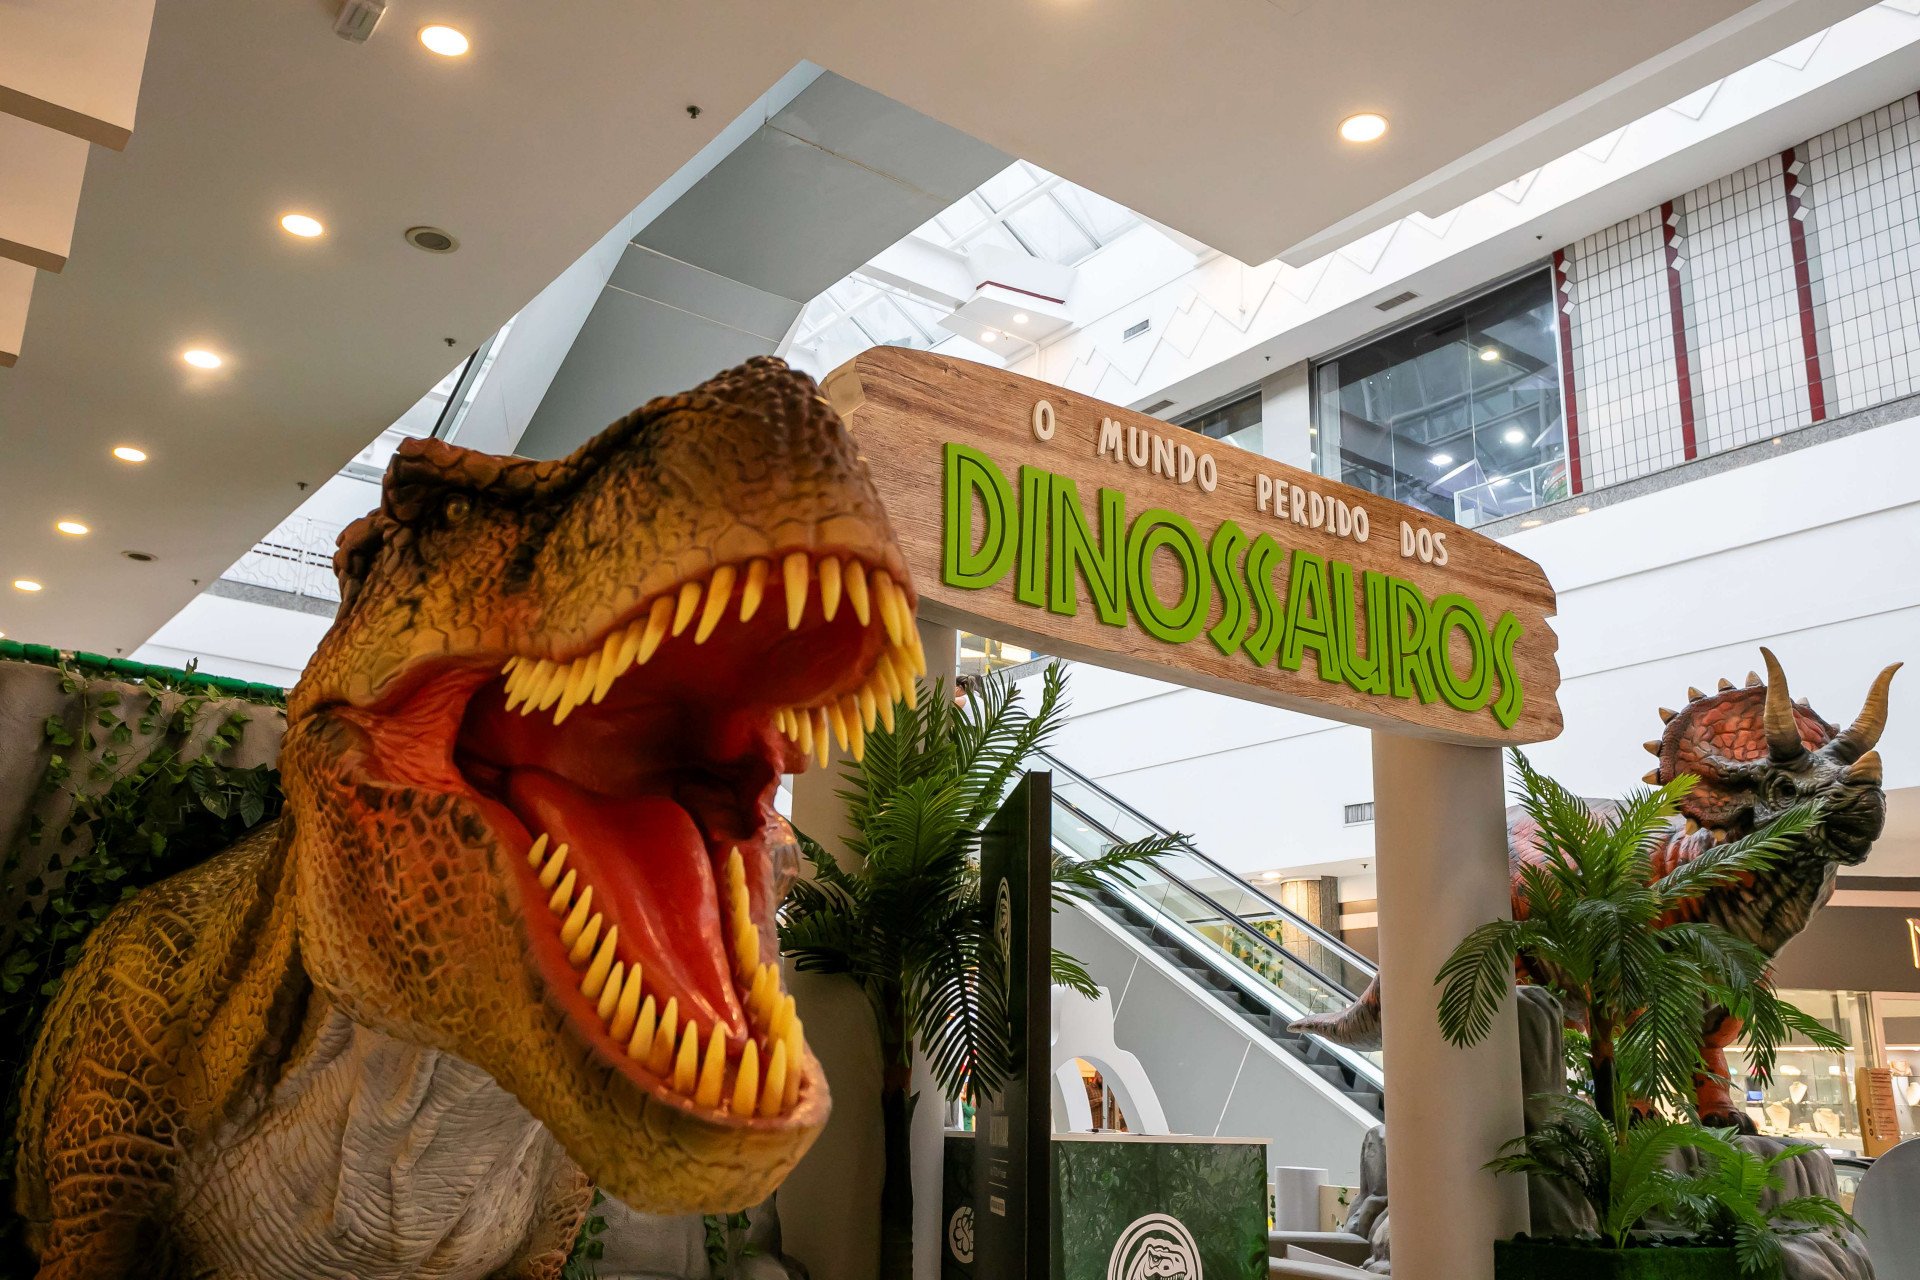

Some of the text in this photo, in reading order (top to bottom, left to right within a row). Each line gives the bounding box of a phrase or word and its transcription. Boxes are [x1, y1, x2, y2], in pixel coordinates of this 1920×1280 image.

[943, 442, 1525, 730] DINOSSAUROS
[1032, 400, 1449, 566] O MUNDO PERDIDO DOS
